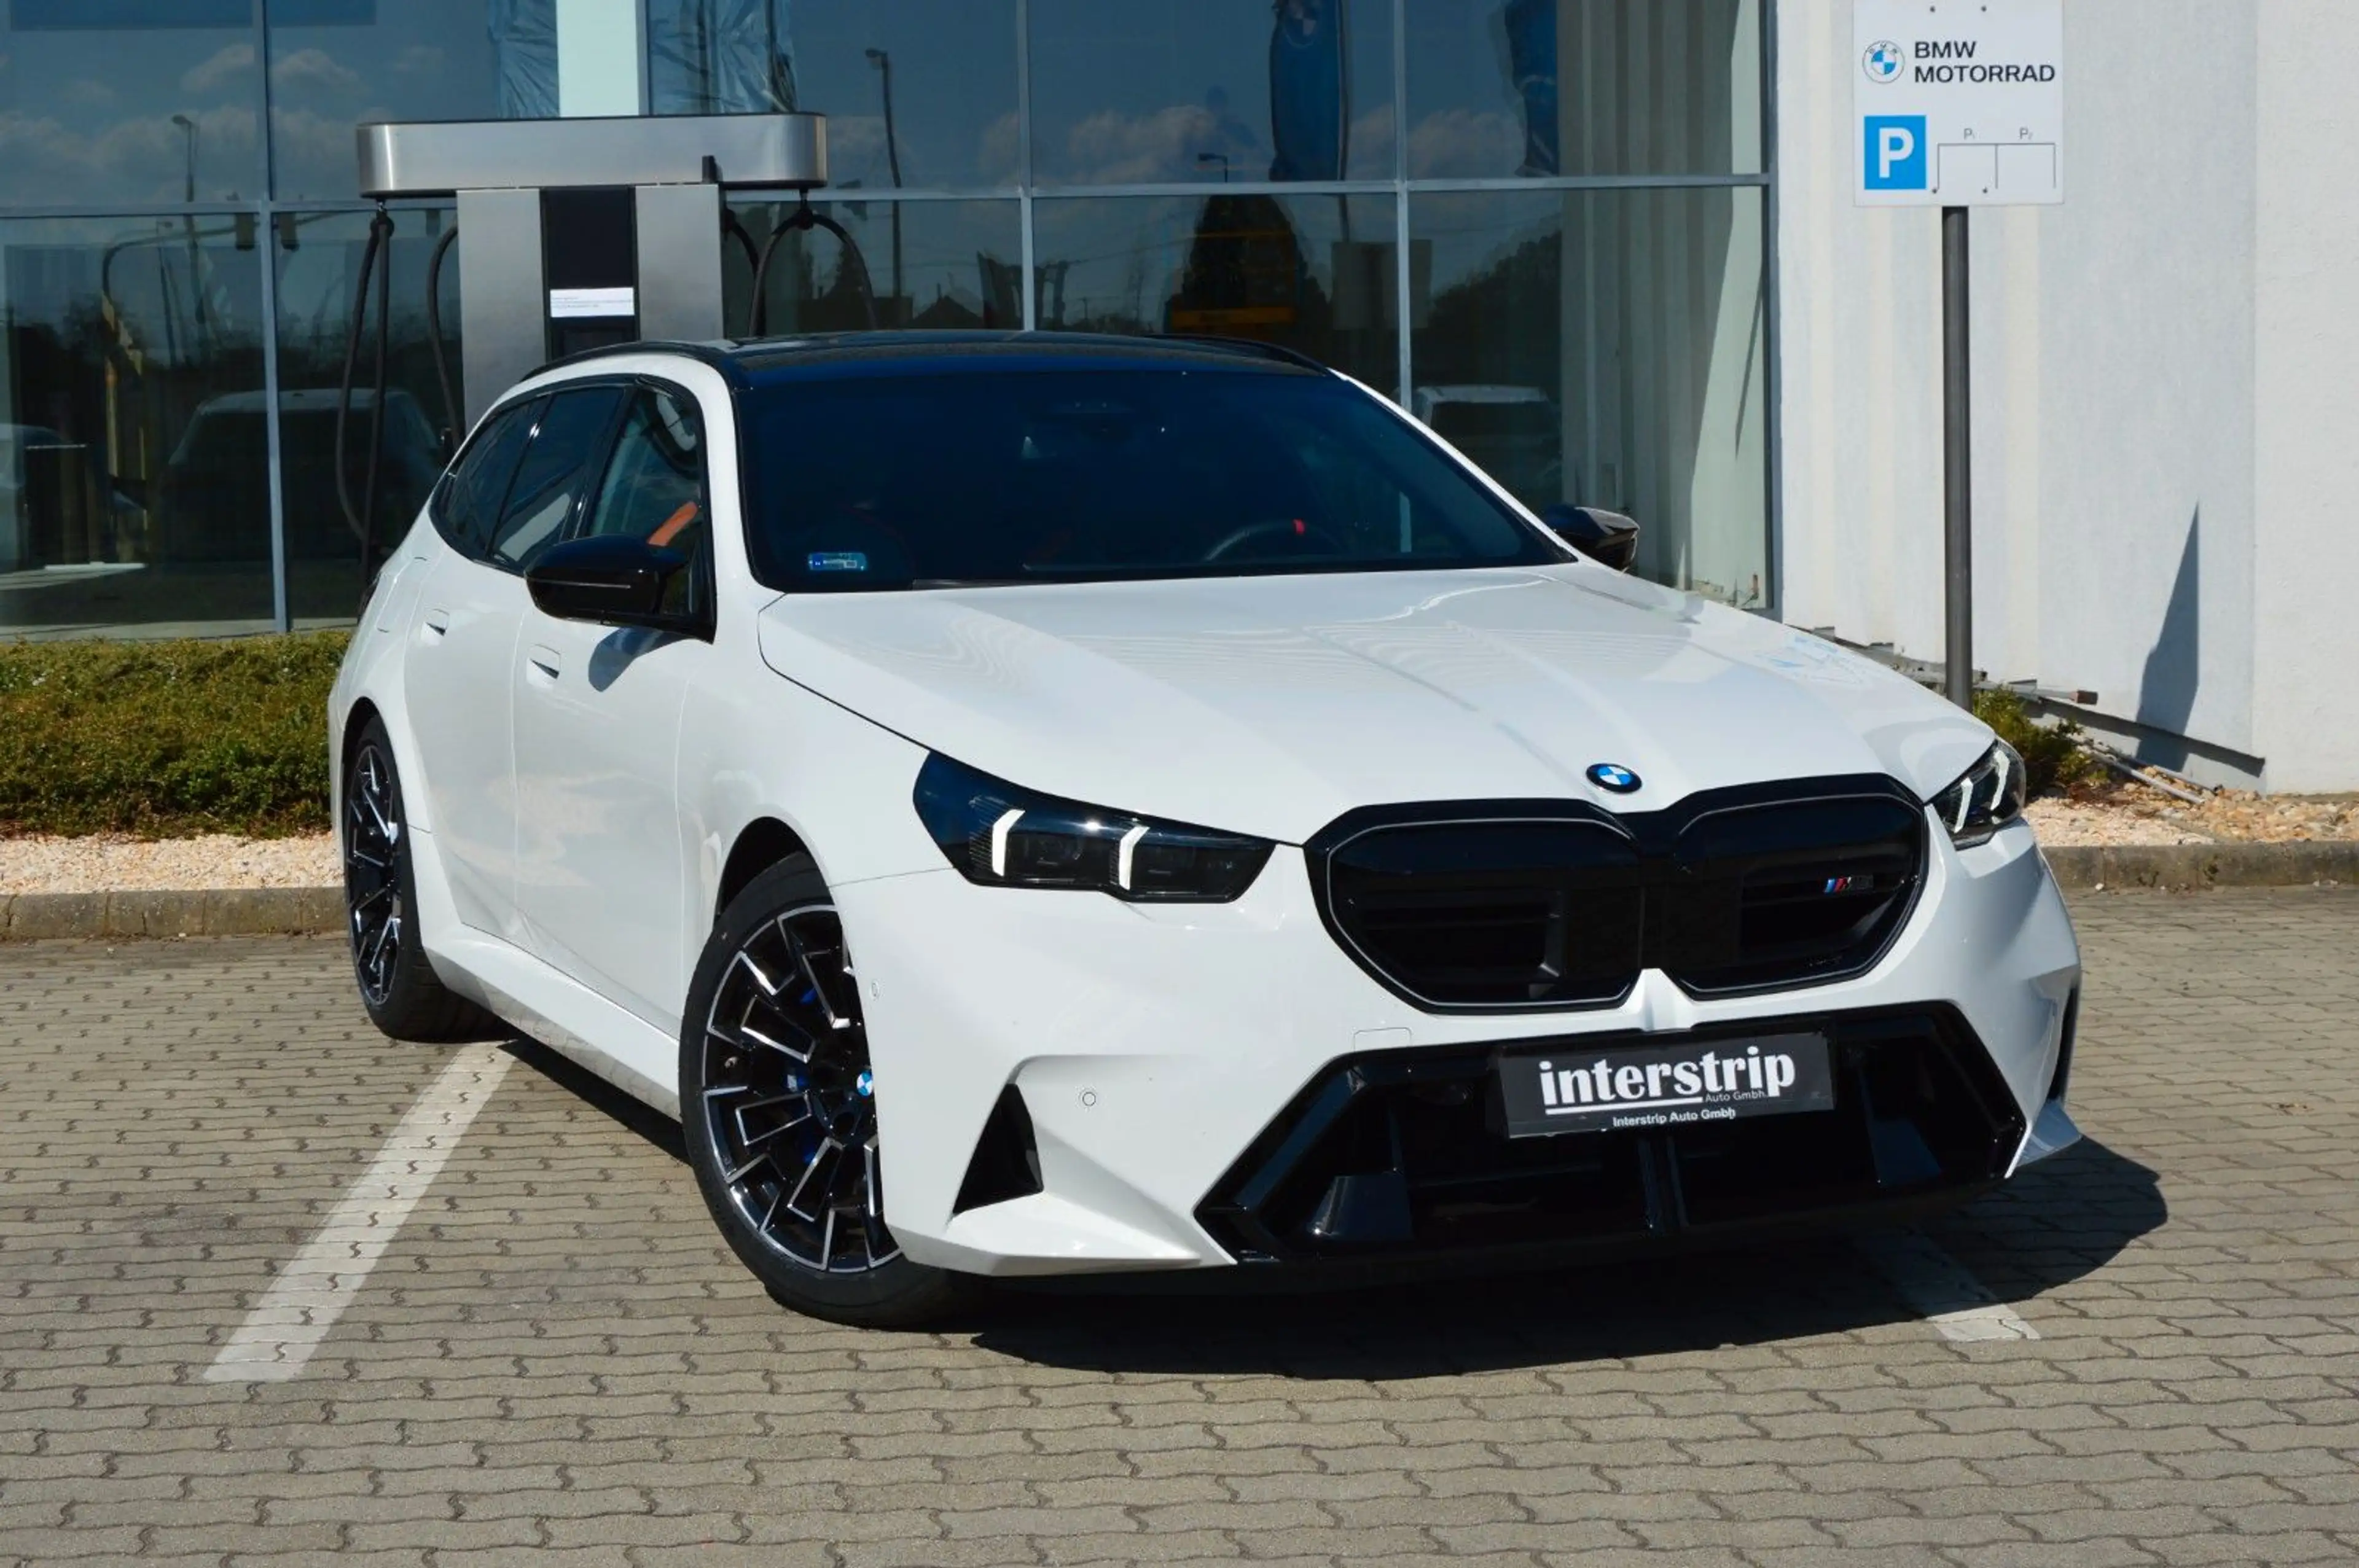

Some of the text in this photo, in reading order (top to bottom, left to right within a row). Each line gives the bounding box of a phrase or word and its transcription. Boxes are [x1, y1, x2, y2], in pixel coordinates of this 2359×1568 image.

[1914, 41, 1976, 58] BMW
[1914, 65, 2055, 83] MOTORRAD
[1879, 127, 1914, 179] P
[1539, 1046, 1795, 1106] interstrip
[1705, 1093, 1730, 1102] Auto
[1613, 1114, 1667, 1127] Interstrip
[1670, 1110, 1698, 1123] Auto
